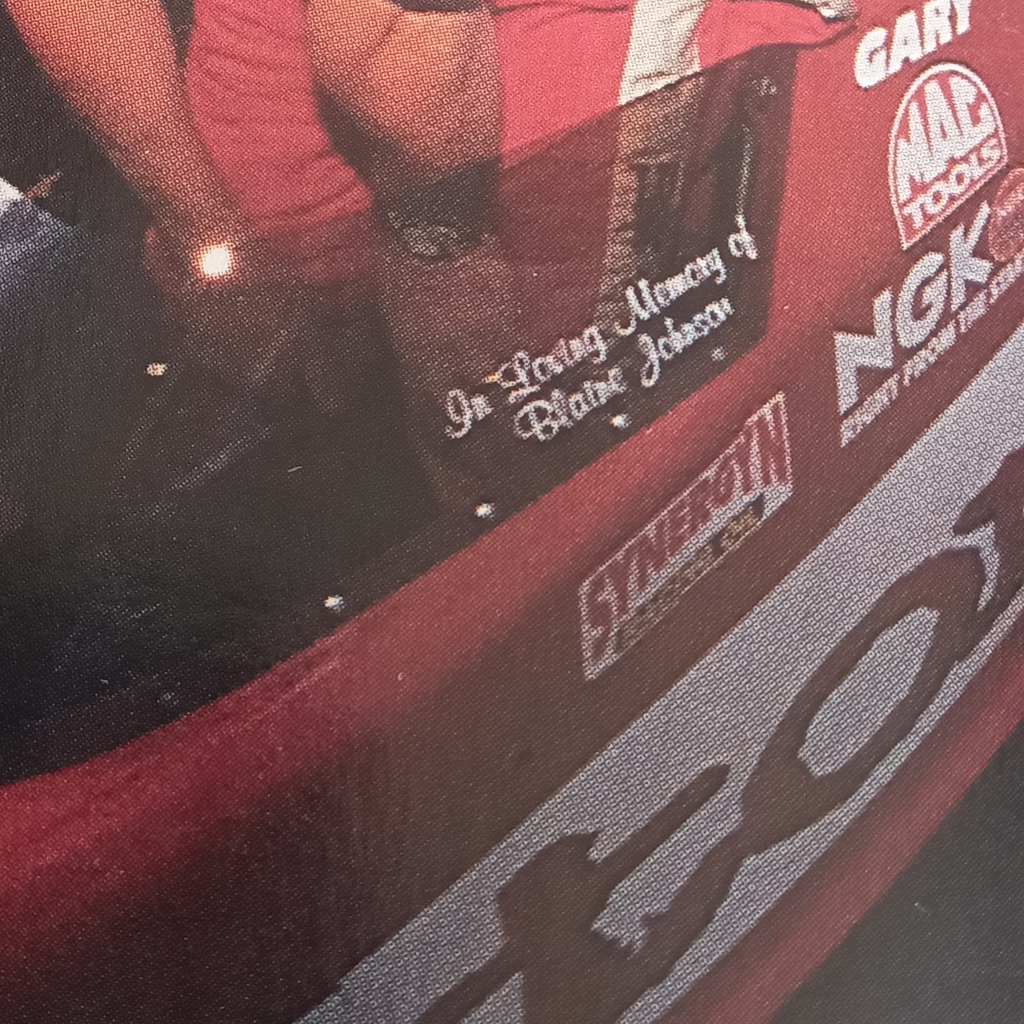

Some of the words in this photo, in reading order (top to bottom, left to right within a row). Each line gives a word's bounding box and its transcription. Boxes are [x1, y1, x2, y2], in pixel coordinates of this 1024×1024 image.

[895, 75, 997, 202] MAC
[903, 137, 1002, 229] TOOLS
[444, 387, 493, 439] In
[482, 325, 607, 403] Loving
[616, 247, 727, 337] Memory
[728, 212, 759, 260] of
[512, 367, 627, 442] Blaine
[637, 297, 734, 388] Johnson
[832, 199, 994, 416] NGK
